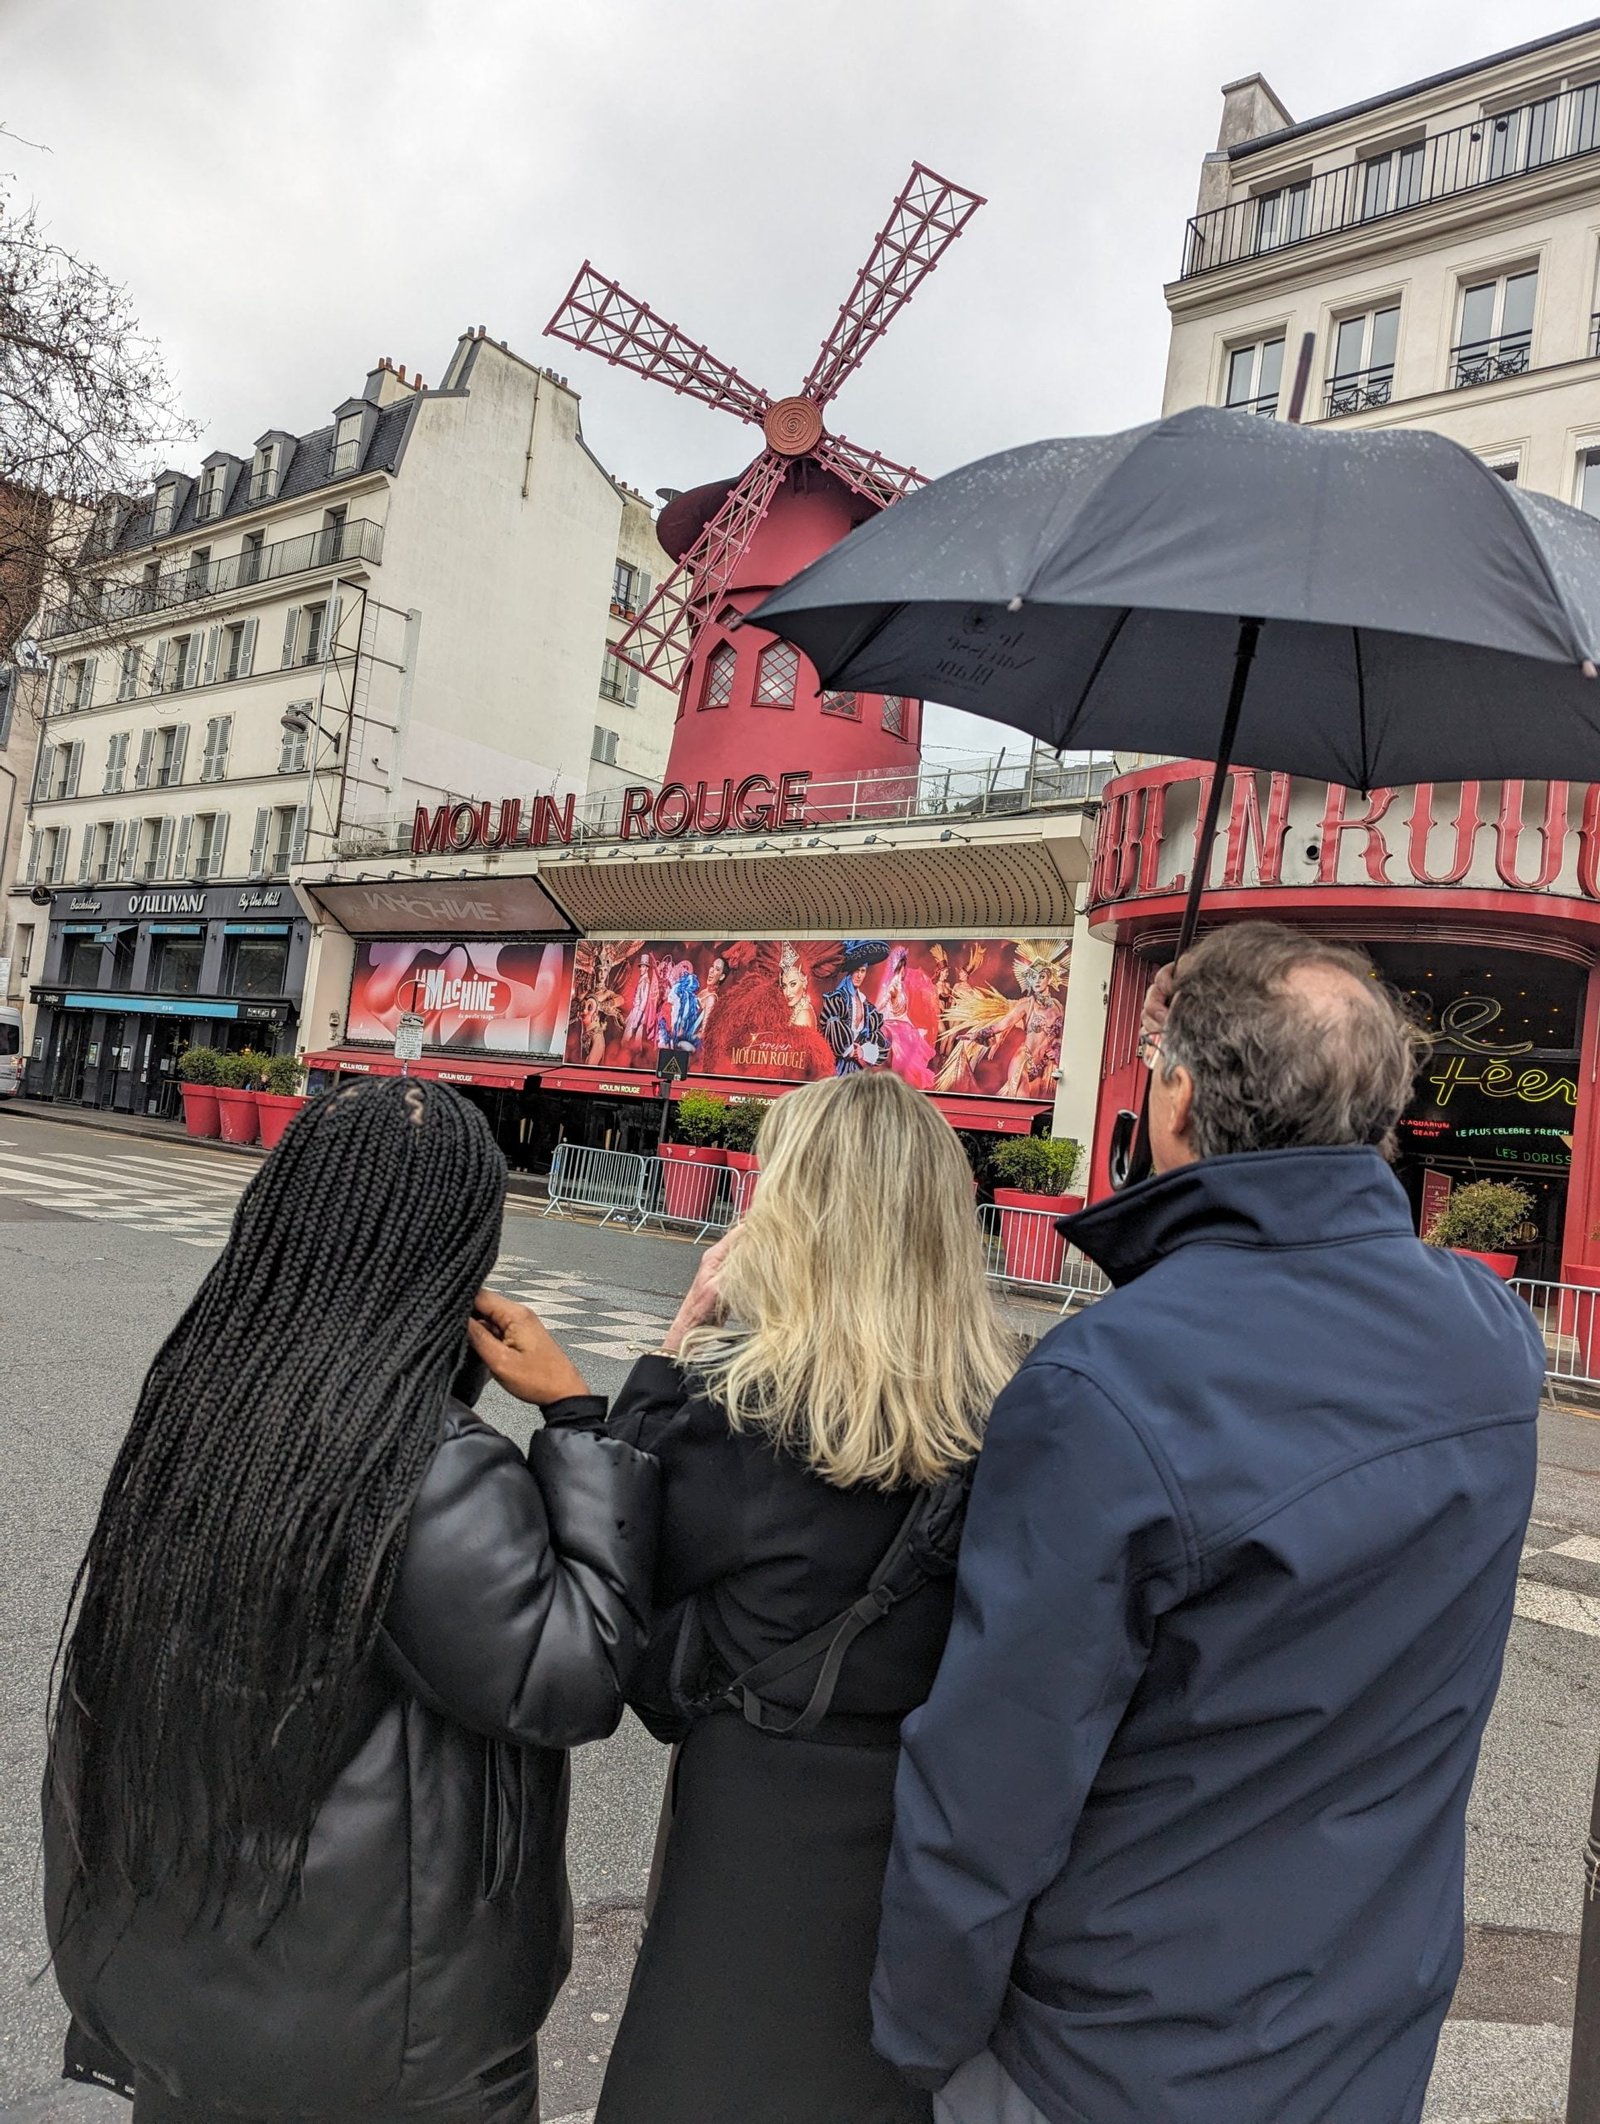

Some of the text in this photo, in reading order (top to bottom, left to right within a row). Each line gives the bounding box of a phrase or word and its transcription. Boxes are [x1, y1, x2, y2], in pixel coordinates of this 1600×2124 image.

[411, 770, 812, 854] MOULIN ROUGE
[70, 897, 101, 914] Backstage
[128, 893, 206, 914] O'SULLIVANS
[238, 891, 281, 911] By the Mill
[742, 1031, 792, 1051] Forever
[340, 1061, 370, 1072] MOULIN ROUGE
[731, 1047, 806, 1070] MOULIN ROUGE
[438, 1072, 472, 1082] MOULIN ROUGE
[598, 1084, 641, 1094] MOULIN ROUGE
[1455, 1130, 1467, 1138] LE
[1469, 1128, 1491, 1137] PLUS
[1492, 1127, 1532, 1136] CELEBRE
[1496, 1145, 1518, 1160] LES
